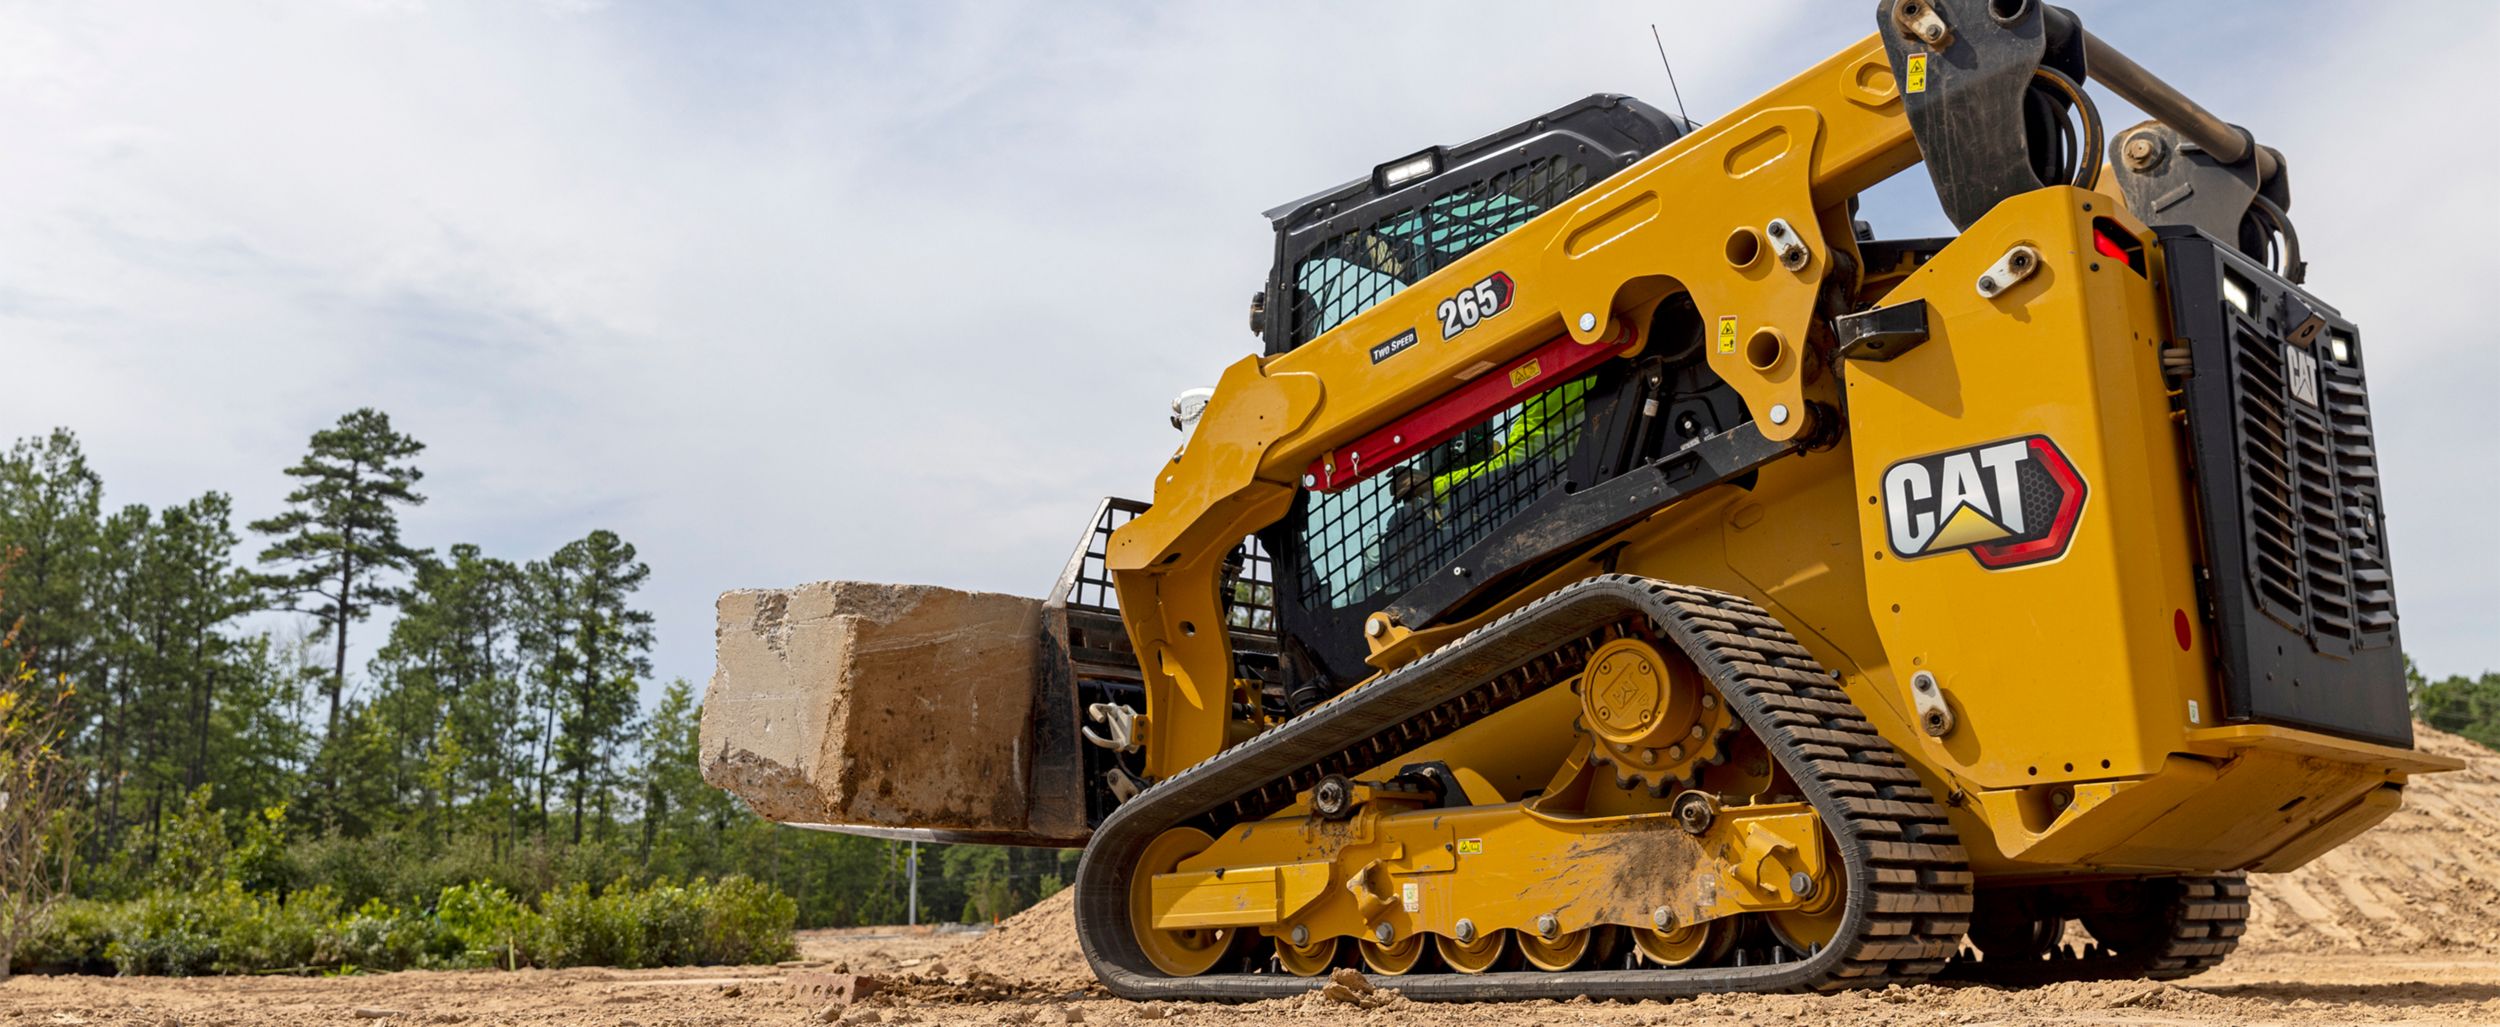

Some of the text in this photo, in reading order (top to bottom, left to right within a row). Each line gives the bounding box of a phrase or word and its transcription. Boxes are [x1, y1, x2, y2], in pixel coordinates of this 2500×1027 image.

[1438, 278, 1498, 338] 265
[2287, 345, 2318, 407] CAT
[1885, 440, 2028, 554] CAT
